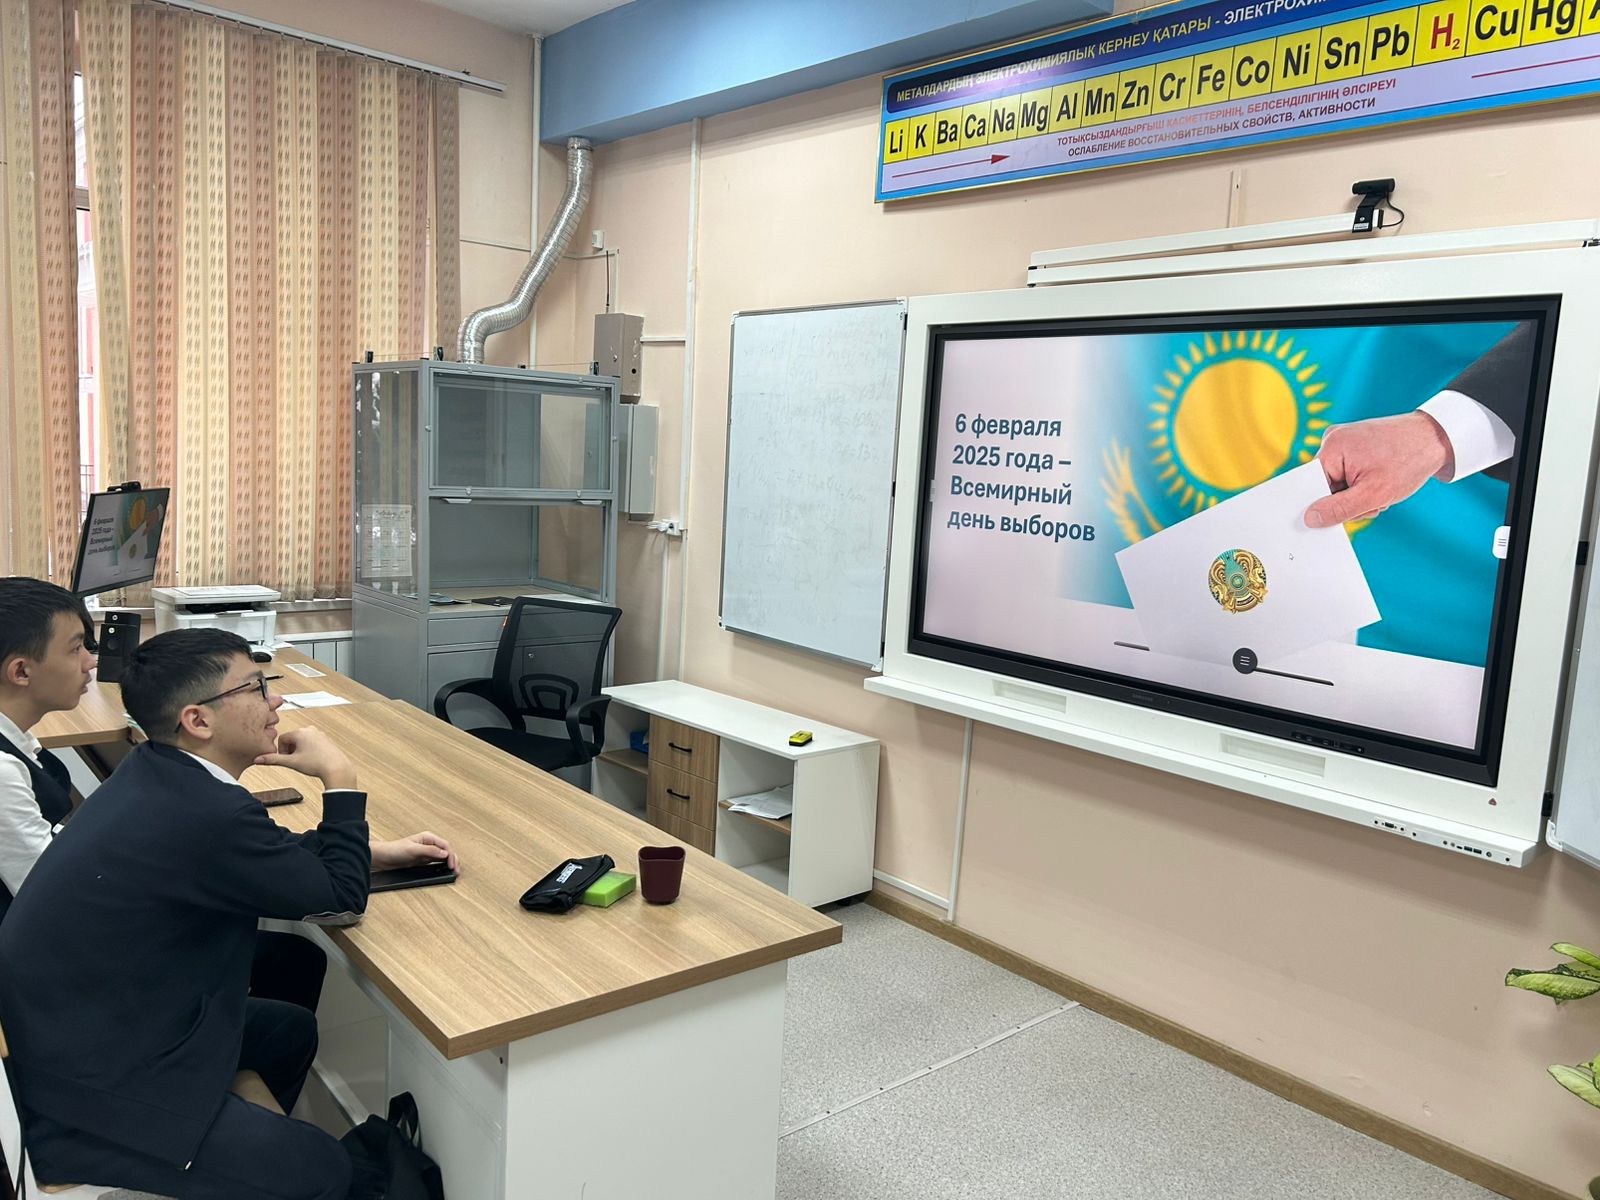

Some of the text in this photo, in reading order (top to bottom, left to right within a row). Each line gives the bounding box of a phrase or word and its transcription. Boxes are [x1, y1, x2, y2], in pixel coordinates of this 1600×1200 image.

[896, 76, 974, 102] МЕТАЛДАРДЫҢ
[976, 44, 1096, 84] ЭЛЕКТРОХИМИЯЛЫҚ
[1098, 31, 1150, 55] КЕРНЕУ
[1152, 16, 1211, 43] ҚАТАРЫ
[889, 128, 903, 154] Li
[915, 123, 928, 149] K
[937, 119, 958, 145] Ba
[964, 114, 986, 139] Ca
[992, 107, 1015, 134] Na
[1020, 101, 1049, 131] Mg
[1056, 92, 1078, 122] Al
[1085, 87, 1115, 116] Mn
[1121, 80, 1150, 110] Zn
[1159, 72, 1187, 101] Cr
[1197, 63, 1226, 95] Fe
[1235, 55, 1270, 87] Co
[1282, 43, 1311, 78] Ni
[1324, 36, 1361, 70] Sn
[1371, 23, 1410, 61] Pb
[1475, 4, 1519, 41] Cu
[1529, 0, 1577, 35] Hg
[1342, 78, 1397, 97] ӘЛСІРЕУІ
[1068, 97, 1376, 157] ОСЛАБЛЕНИЕ ВОССТАНОВИТЕЛЬНЫХ СВОЙСТВ, АКТИВНОСТИ
[954, 412, 1062, 440] 6 февраля
[952, 444, 1001, 467] 2025
[1005, 448, 1054, 473] года
[950, 475, 1073, 506] Всемирный
[947, 510, 1096, 543] день выборов
